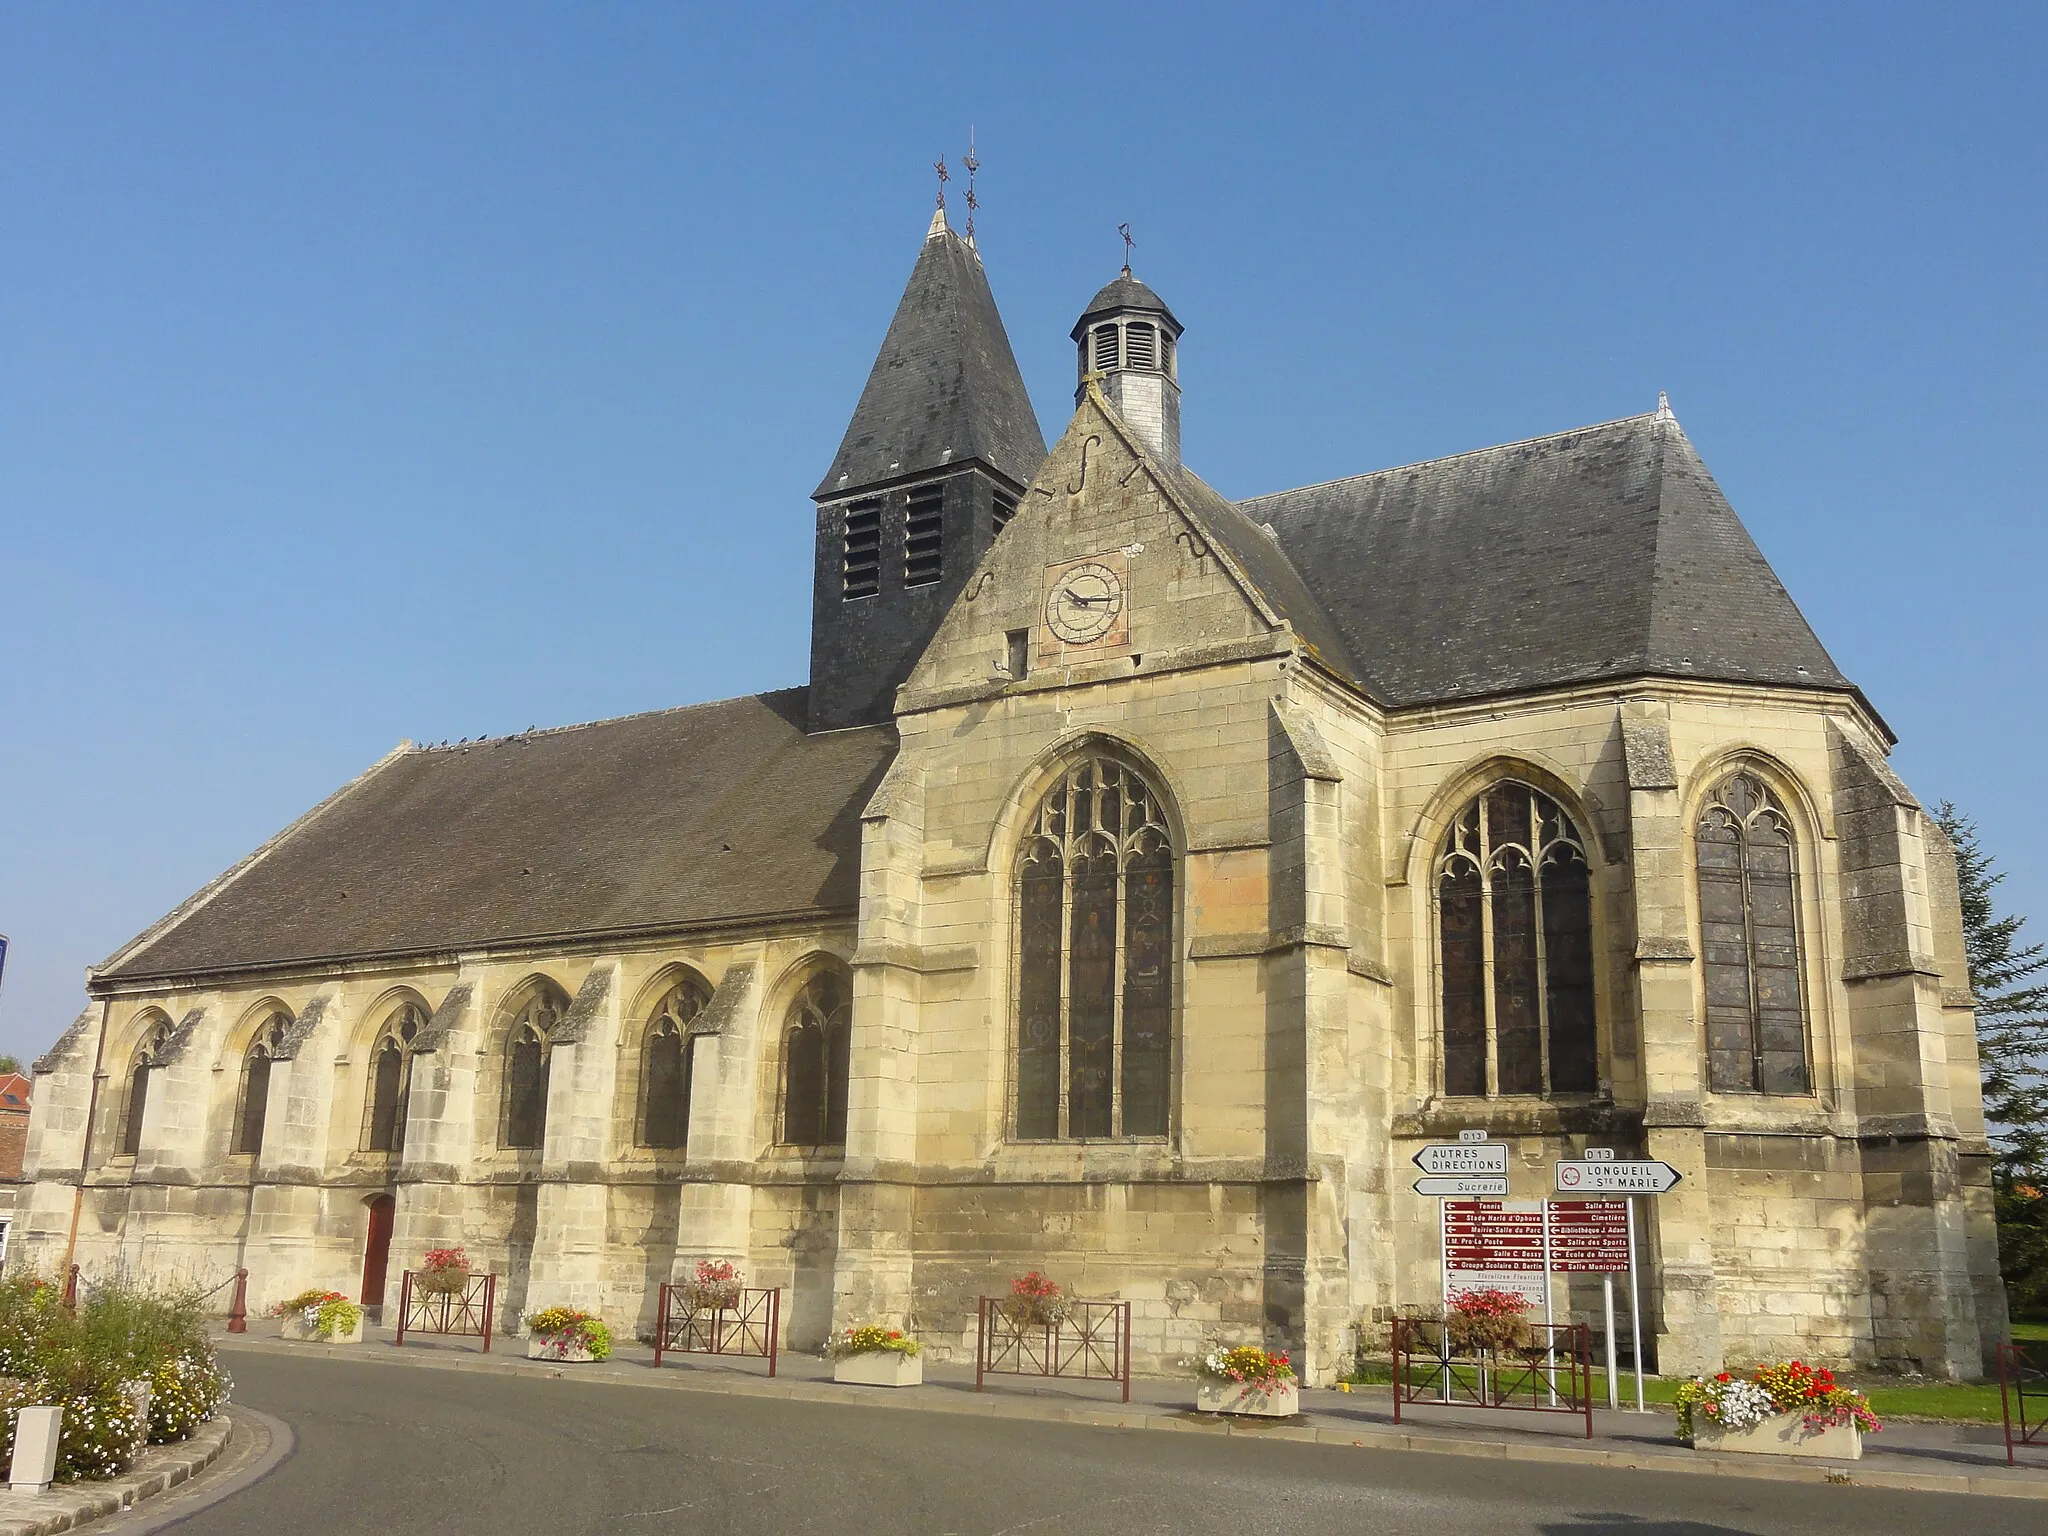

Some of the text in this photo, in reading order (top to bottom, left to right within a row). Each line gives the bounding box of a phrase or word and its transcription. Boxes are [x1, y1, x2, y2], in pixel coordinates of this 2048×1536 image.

[1432, 1150, 1478, 1158] AUTRES
[1587, 1150, 1611, 1158] D 13
[1432, 1160, 1502, 1170] DIRECTIONS
[1587, 1166, 1652, 1176] LONGUEIL
[1458, 1182, 1503, 1191] Sucrerie
[1618, 1178, 1659, 1188] MARIE
